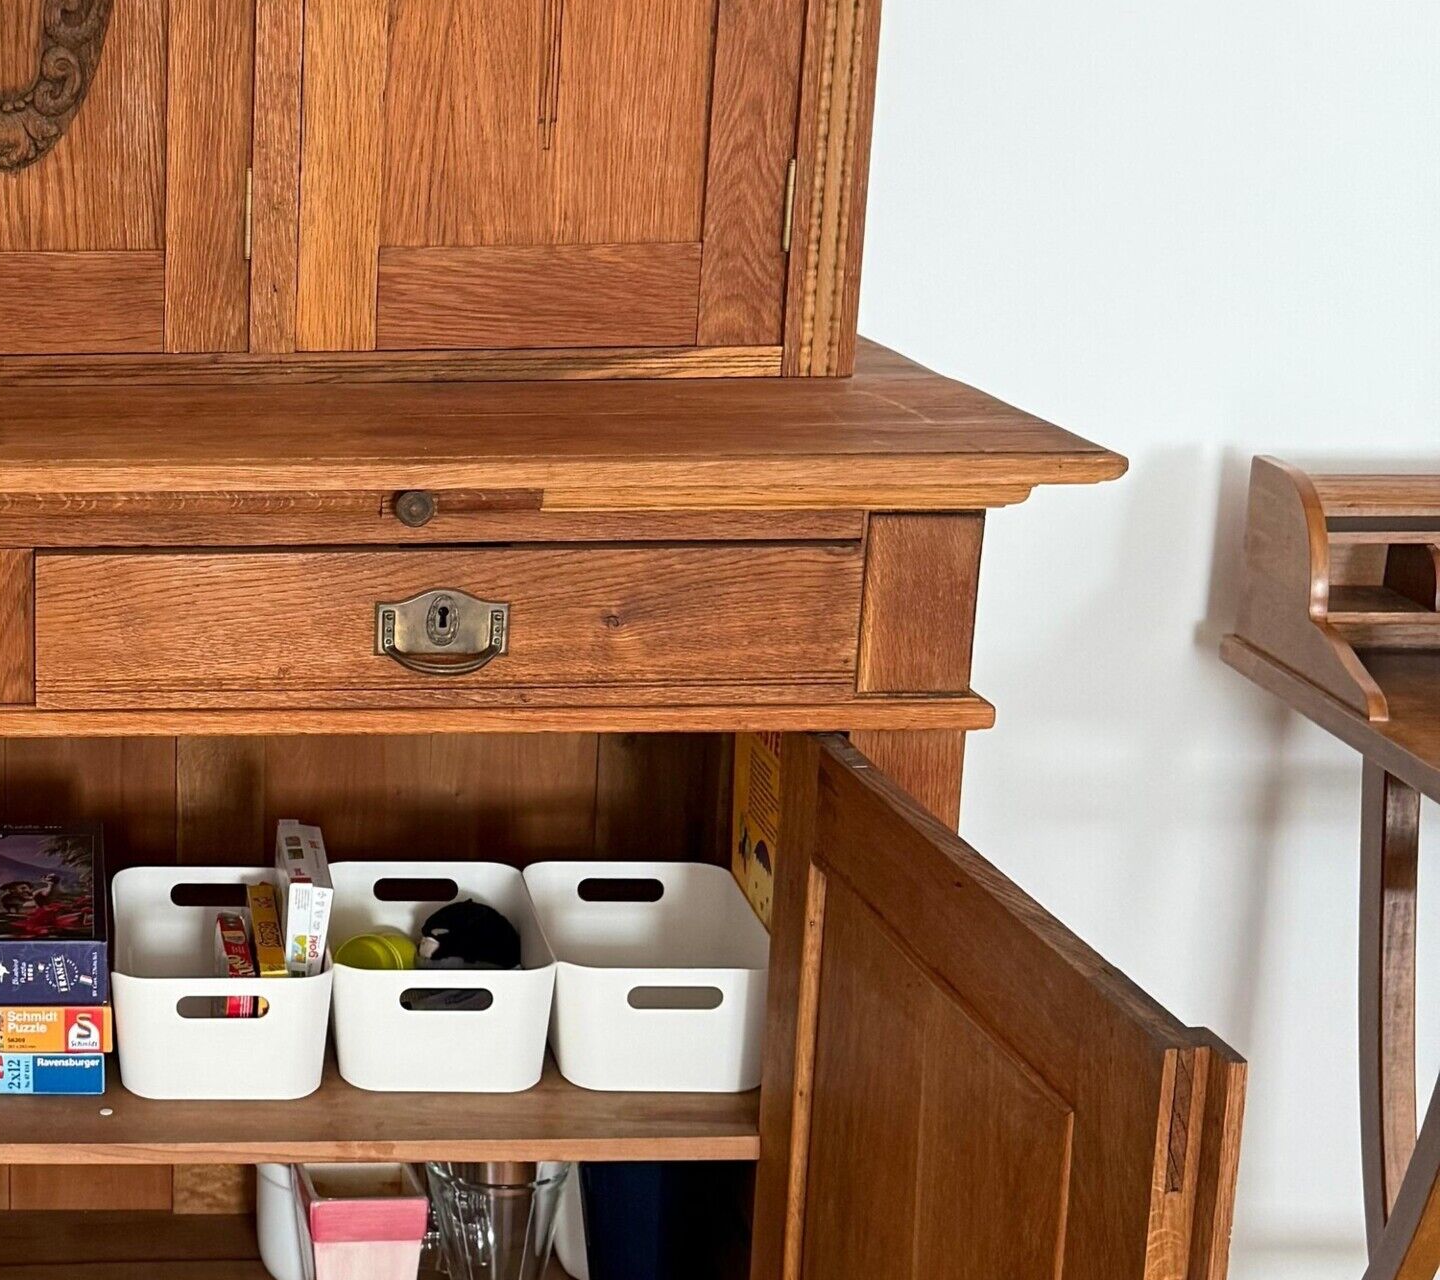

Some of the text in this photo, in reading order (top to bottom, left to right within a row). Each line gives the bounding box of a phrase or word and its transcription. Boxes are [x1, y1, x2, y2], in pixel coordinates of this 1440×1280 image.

[53, 956, 68, 992] FRANCE
[7, 1011, 58, 1022] Schmidt
[7, 1022, 48, 1033] Puzzle
[36, 1058, 100, 1069] Ravensburger
[7, 1059, 21, 1090] 2x12
